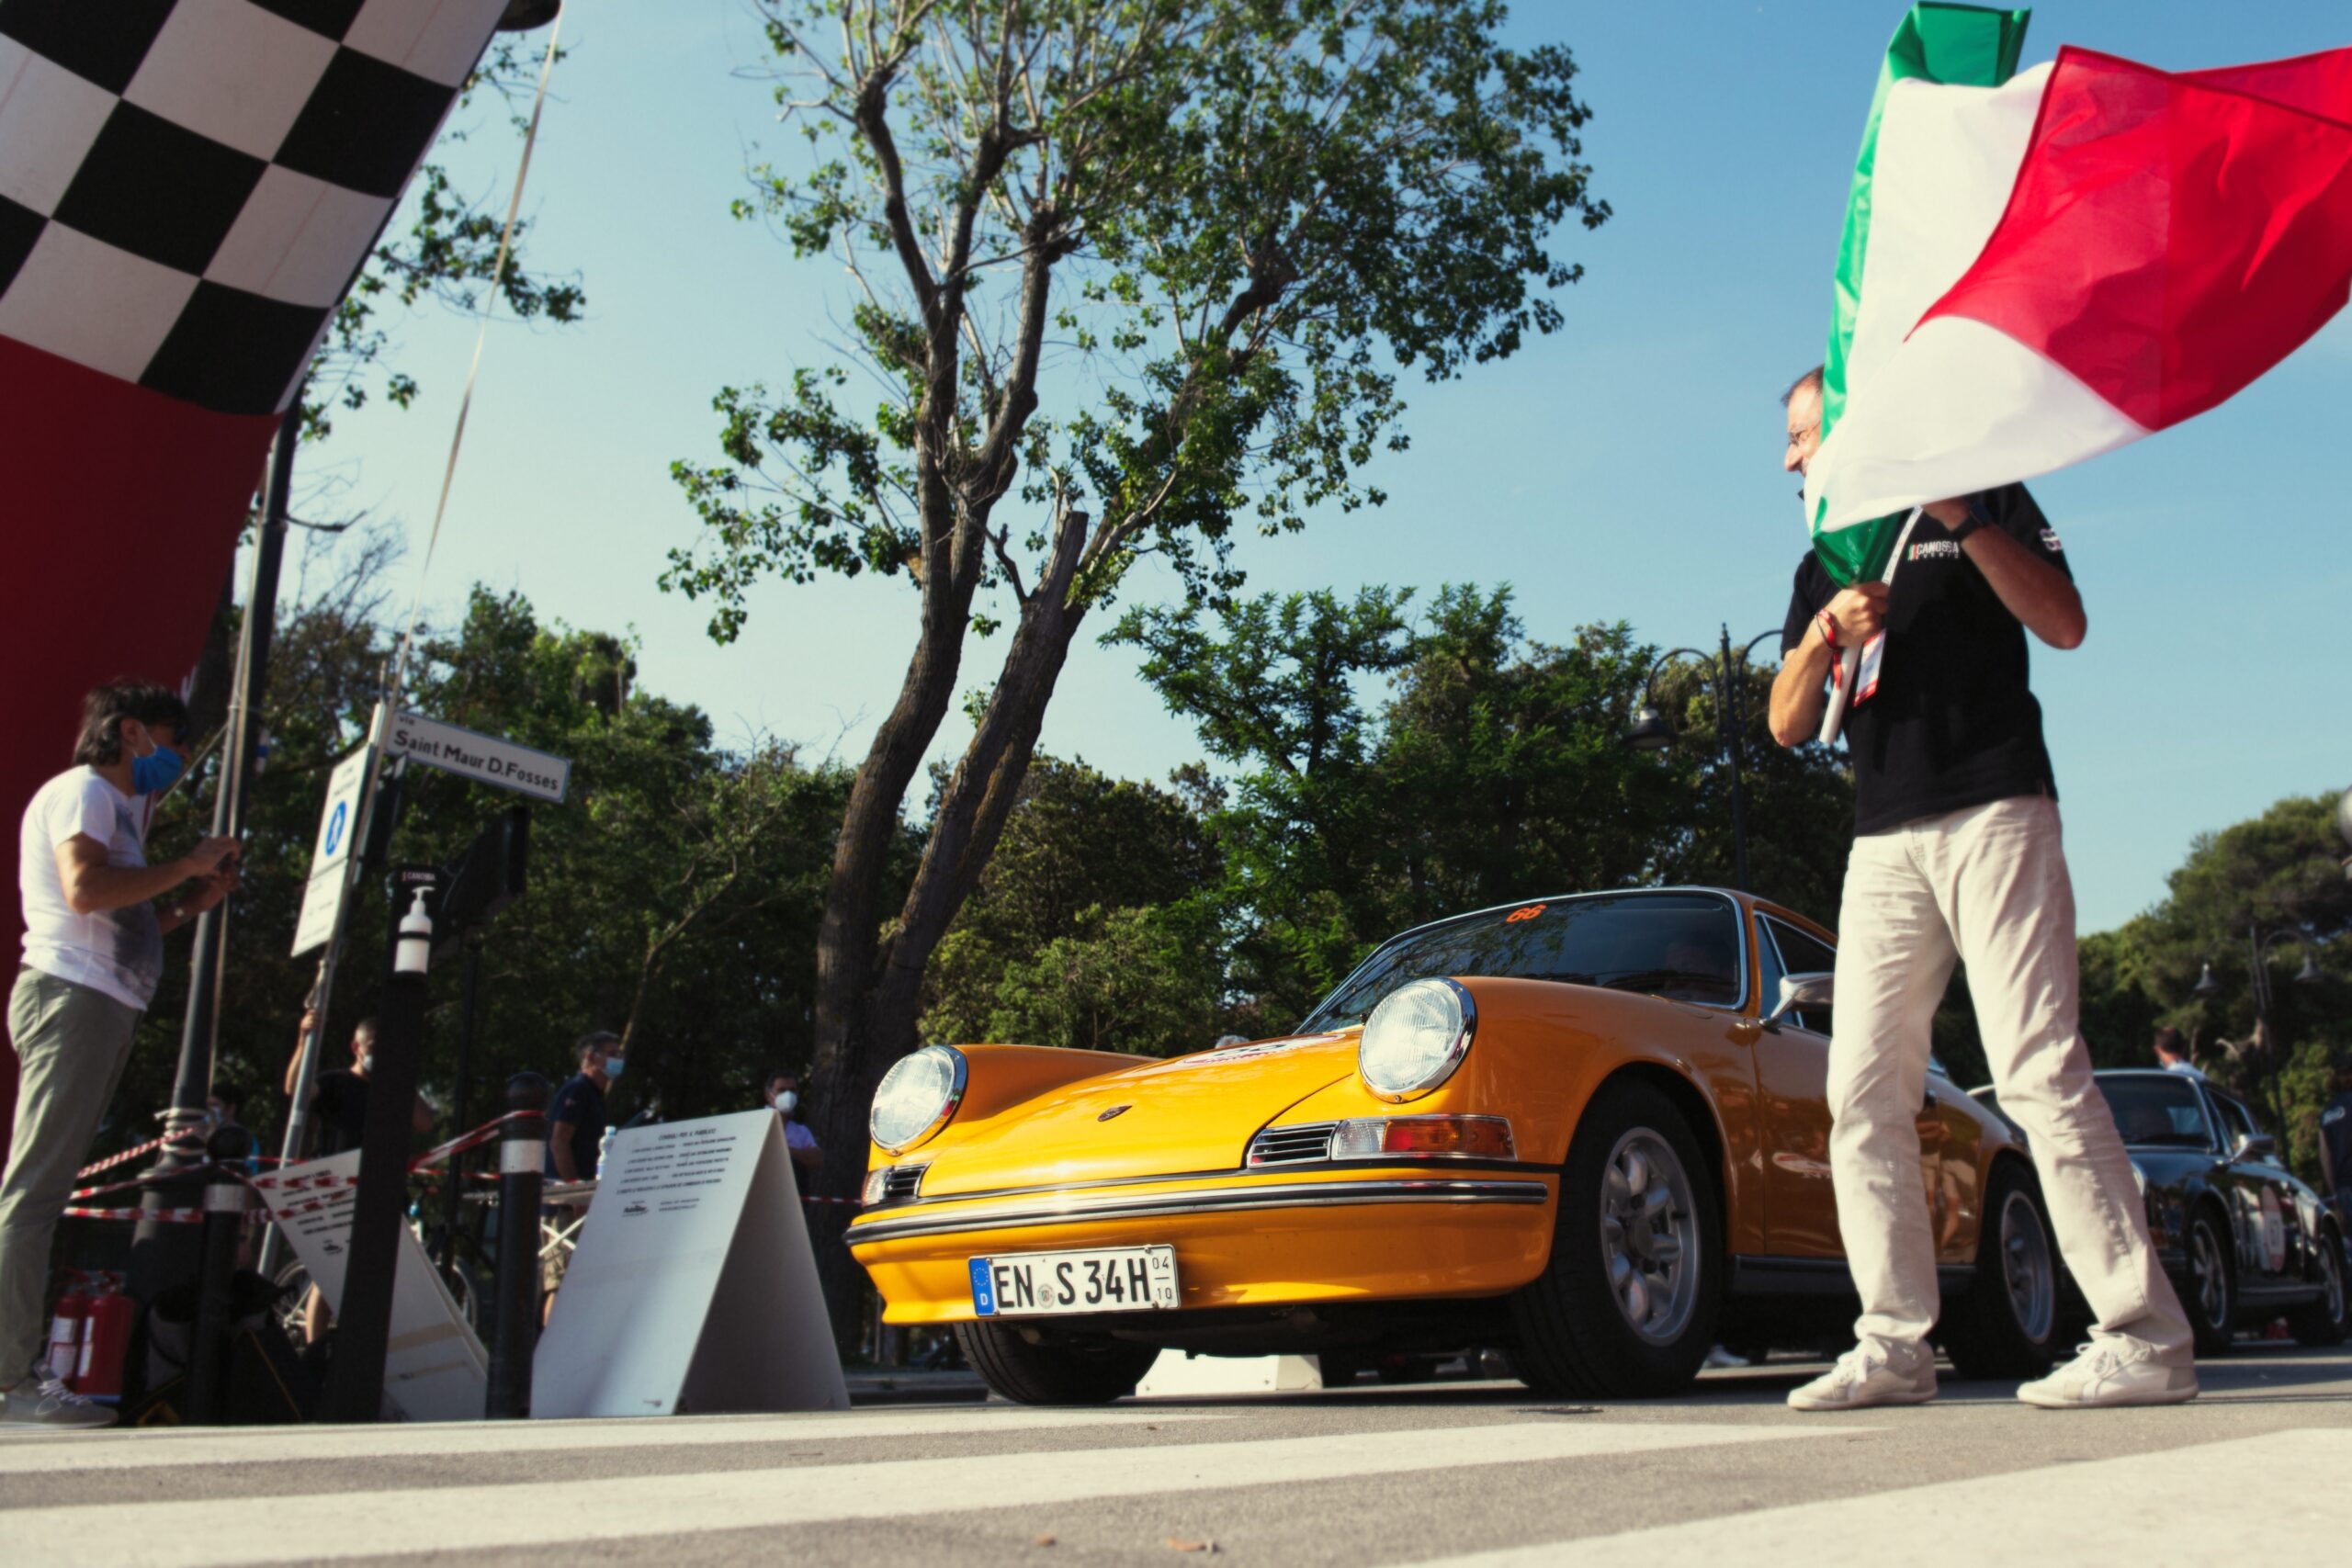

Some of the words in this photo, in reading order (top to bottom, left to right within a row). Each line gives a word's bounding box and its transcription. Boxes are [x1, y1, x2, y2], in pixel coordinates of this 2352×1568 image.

[1917, 540, 1960, 555] CANOSSA
[394, 730, 439, 757] Saint
[443, 744, 485, 769] Maur
[488, 757, 560, 791] D.Fosses
[1506, 904, 1547, 923] 66
[1152, 1256, 1170, 1269] 04
[993, 1264, 1035, 1309] EN
[1056, 1261, 1076, 1305] S
[1083, 1258, 1150, 1304] 34H
[980, 1292, 989, 1306] D
[1157, 1287, 1172, 1300] 10
